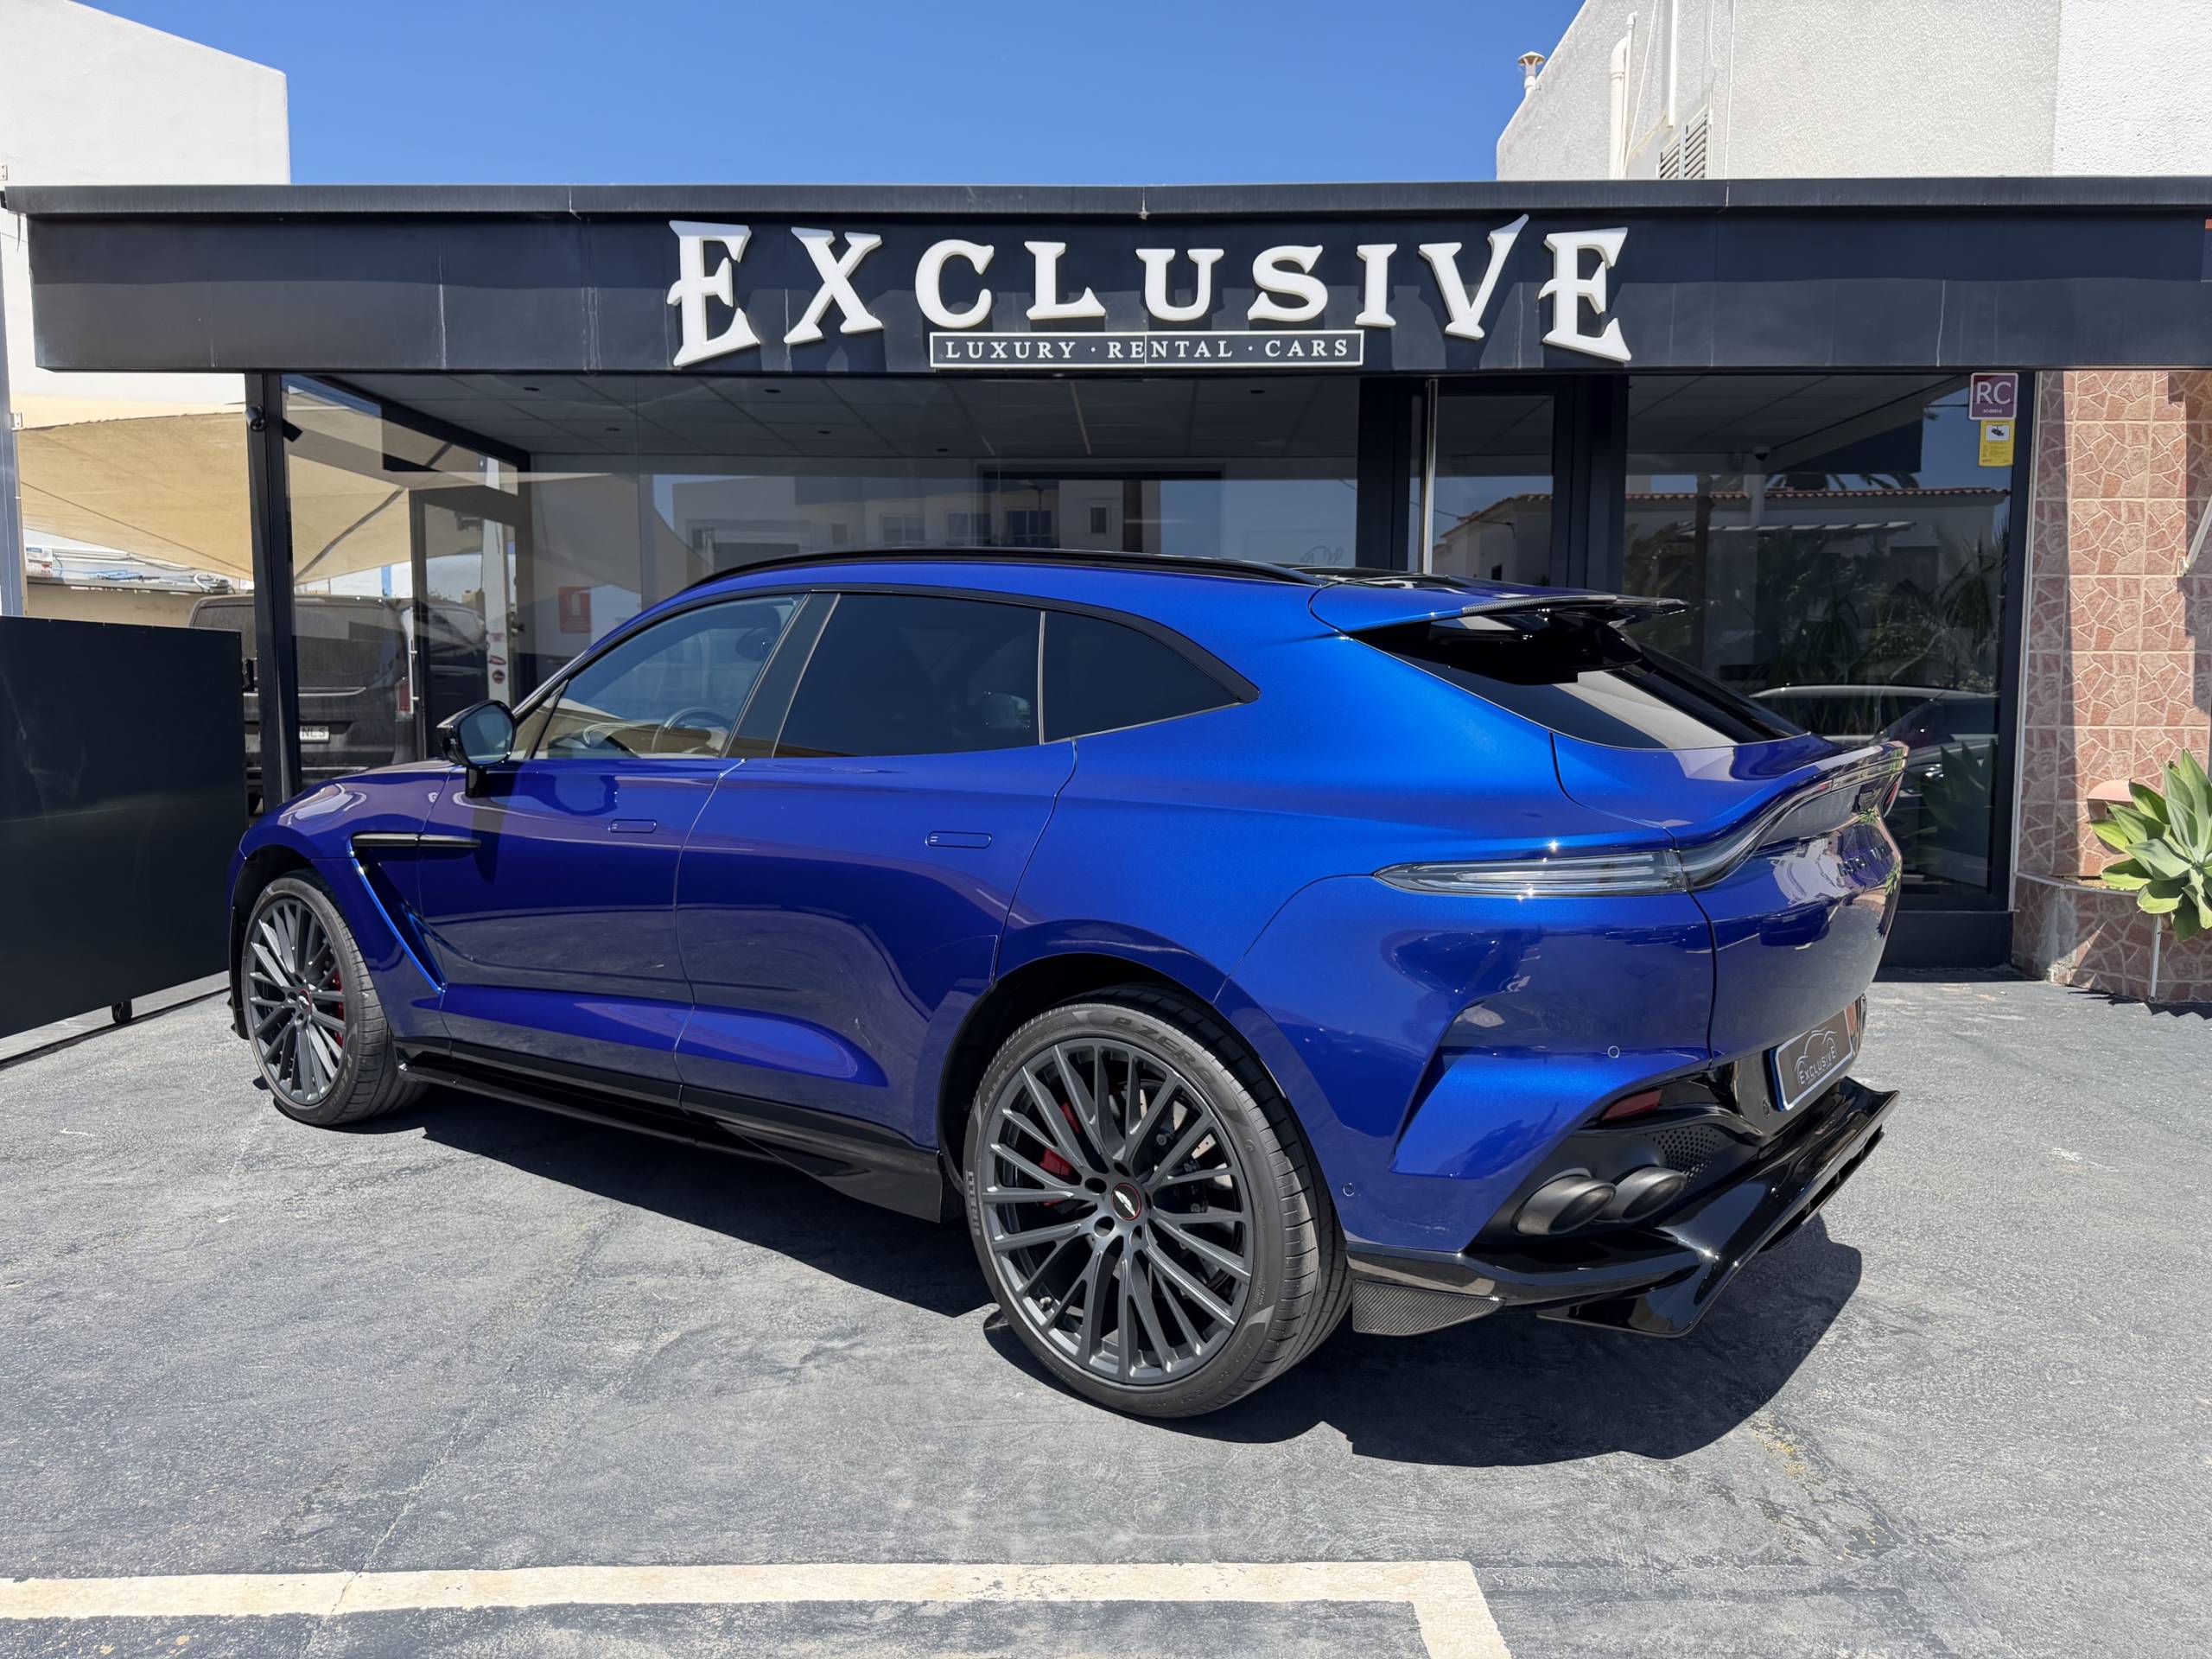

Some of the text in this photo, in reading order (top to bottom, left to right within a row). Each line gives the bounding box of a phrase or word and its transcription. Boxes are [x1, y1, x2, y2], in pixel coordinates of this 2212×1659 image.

[667, 214, 1631, 366] EXCLUSIVE
[945, 339, 1348, 359] LUXURY RENTAL CARS
[1976, 381, 2012, 404] RC
[302, 728, 326, 738] NLS
[1799, 1046, 1836, 1084] EXCLUSIVE
